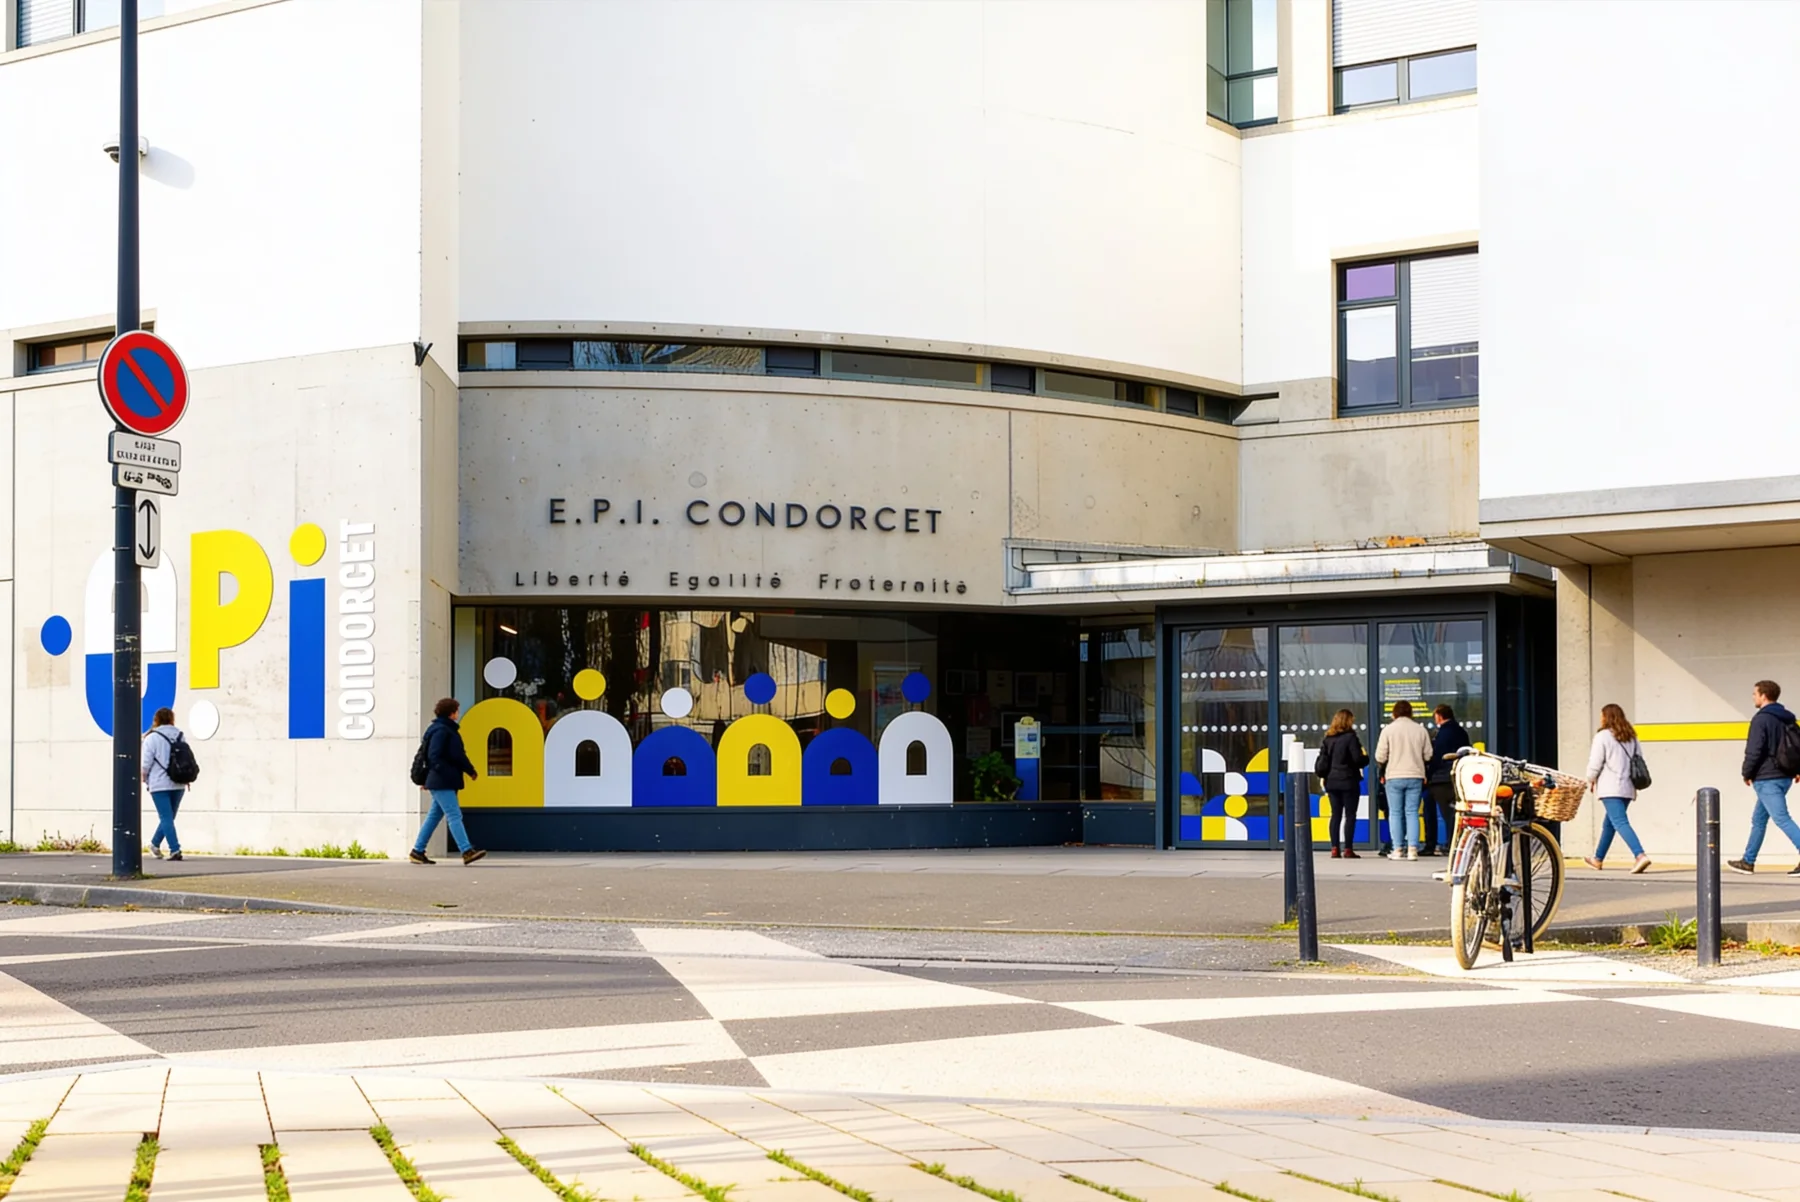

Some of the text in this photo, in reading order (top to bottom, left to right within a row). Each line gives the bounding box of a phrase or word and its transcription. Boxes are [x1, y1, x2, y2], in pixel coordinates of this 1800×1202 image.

[548, 497, 943, 535] E.P.I. CONDORCET
[514, 570, 630, 588] Liberté
[338, 518, 376, 740] CONDORCET
